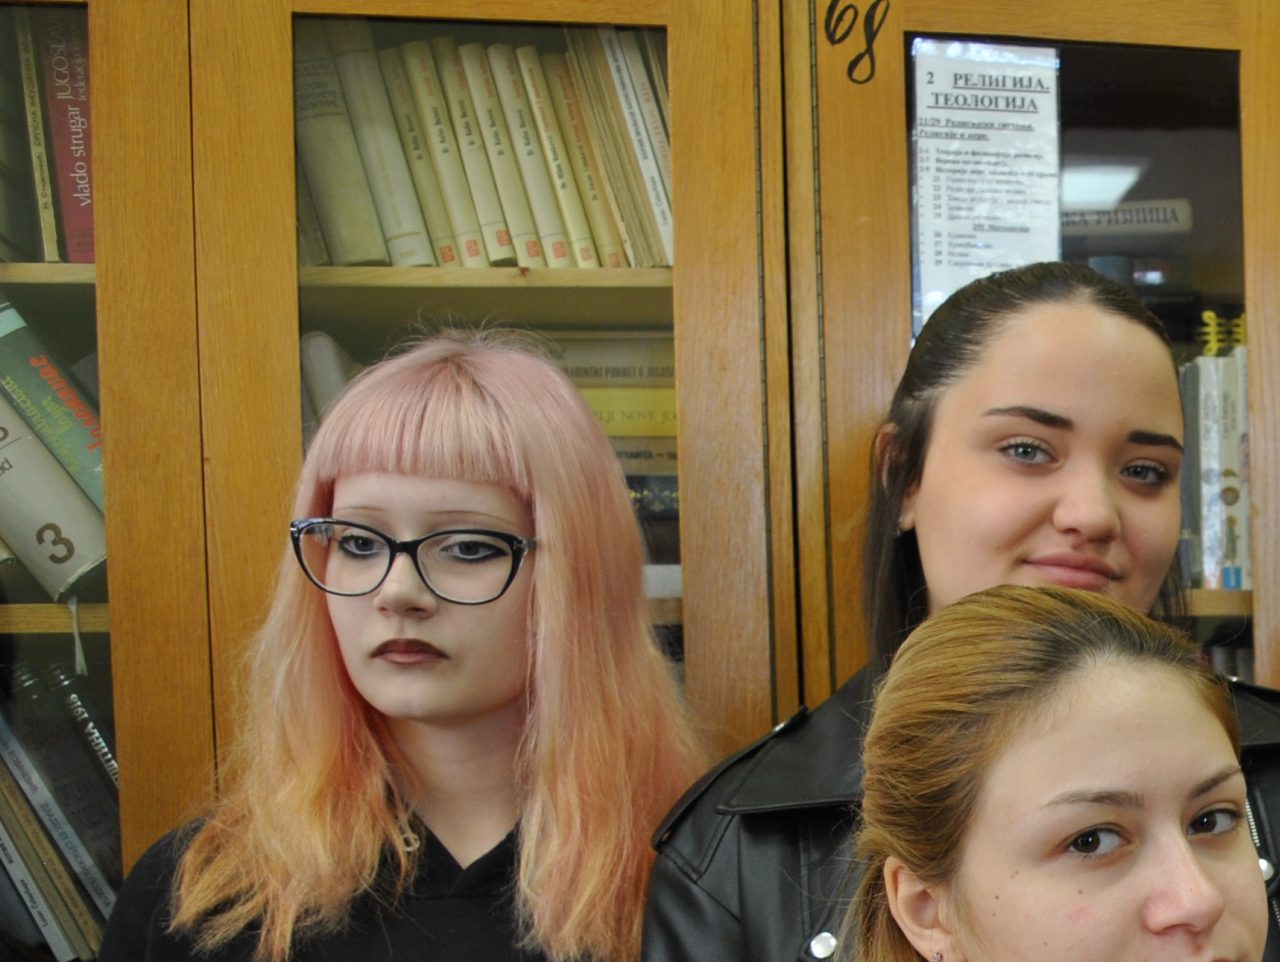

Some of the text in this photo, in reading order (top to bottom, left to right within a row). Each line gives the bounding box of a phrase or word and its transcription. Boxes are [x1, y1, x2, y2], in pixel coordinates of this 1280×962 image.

[824, 0, 890, 84] 68
[926, 72, 1050, 92] 2 РЕЛИГИЈА.
[930, 93, 1038, 112] ТЕОЛОГИЈА
[68, 106, 91, 206] vlado strugar
[36, 523, 75, 564] 3
